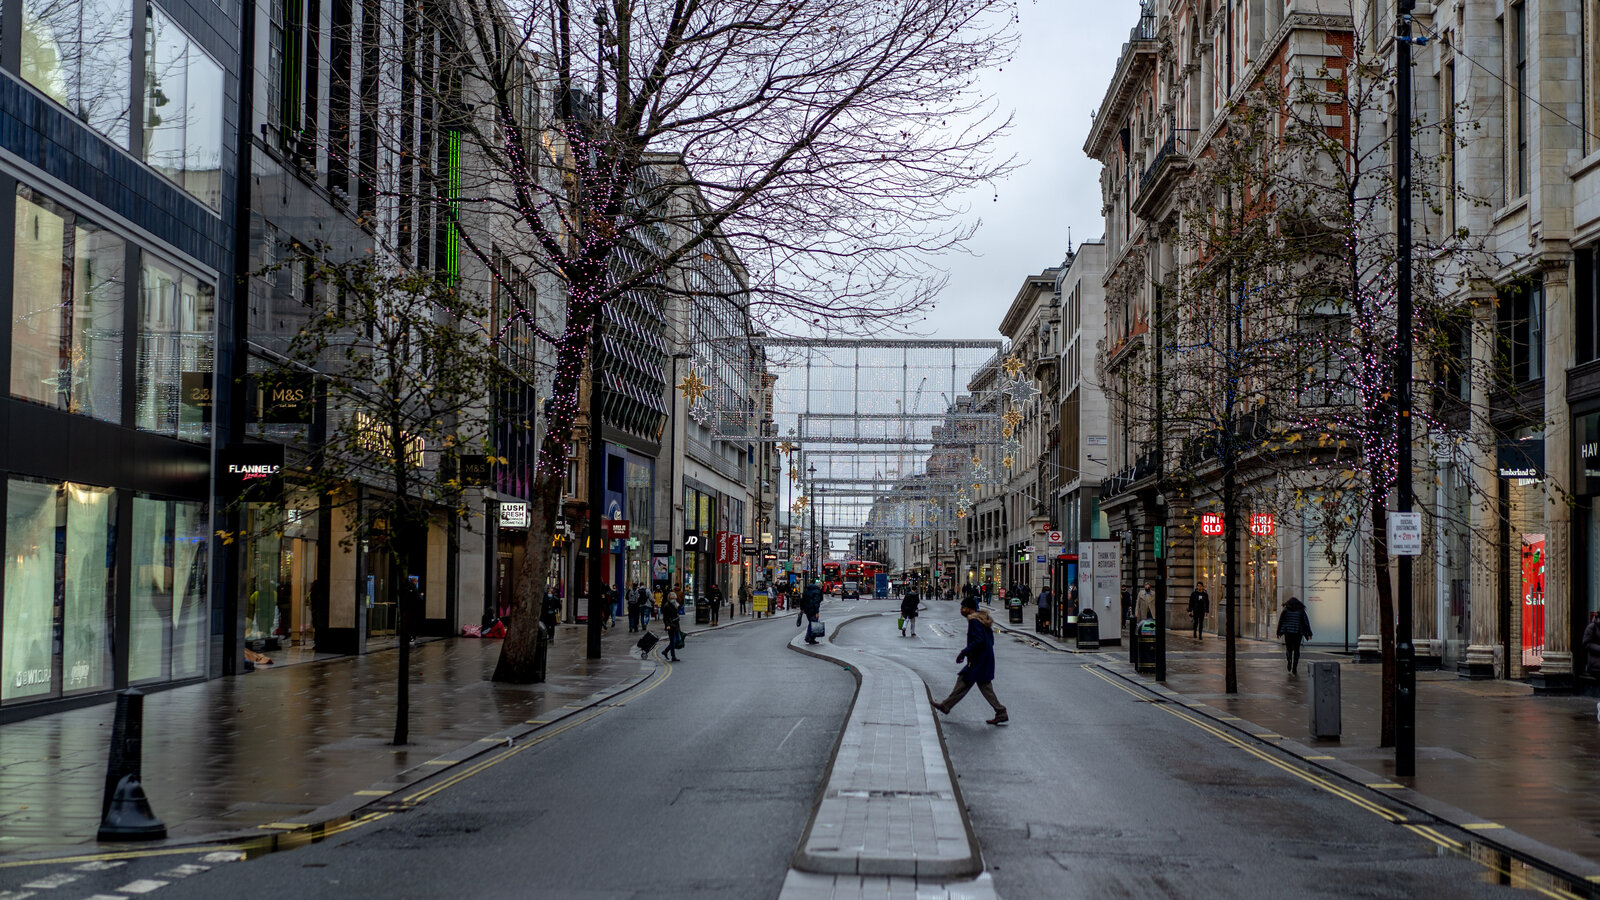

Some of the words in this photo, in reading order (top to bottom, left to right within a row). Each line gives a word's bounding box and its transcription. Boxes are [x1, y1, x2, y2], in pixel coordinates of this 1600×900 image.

[272, 388, 304, 401] M&S
[228, 464, 281, 474] FLANNELS
[465, 464, 486, 473] M&S
[1499, 468, 1529, 476] Timberland
[1203, 515, 1220, 524] UNI
[1203, 524, 1221, 534] QLO
[685, 536, 698, 545] JD
